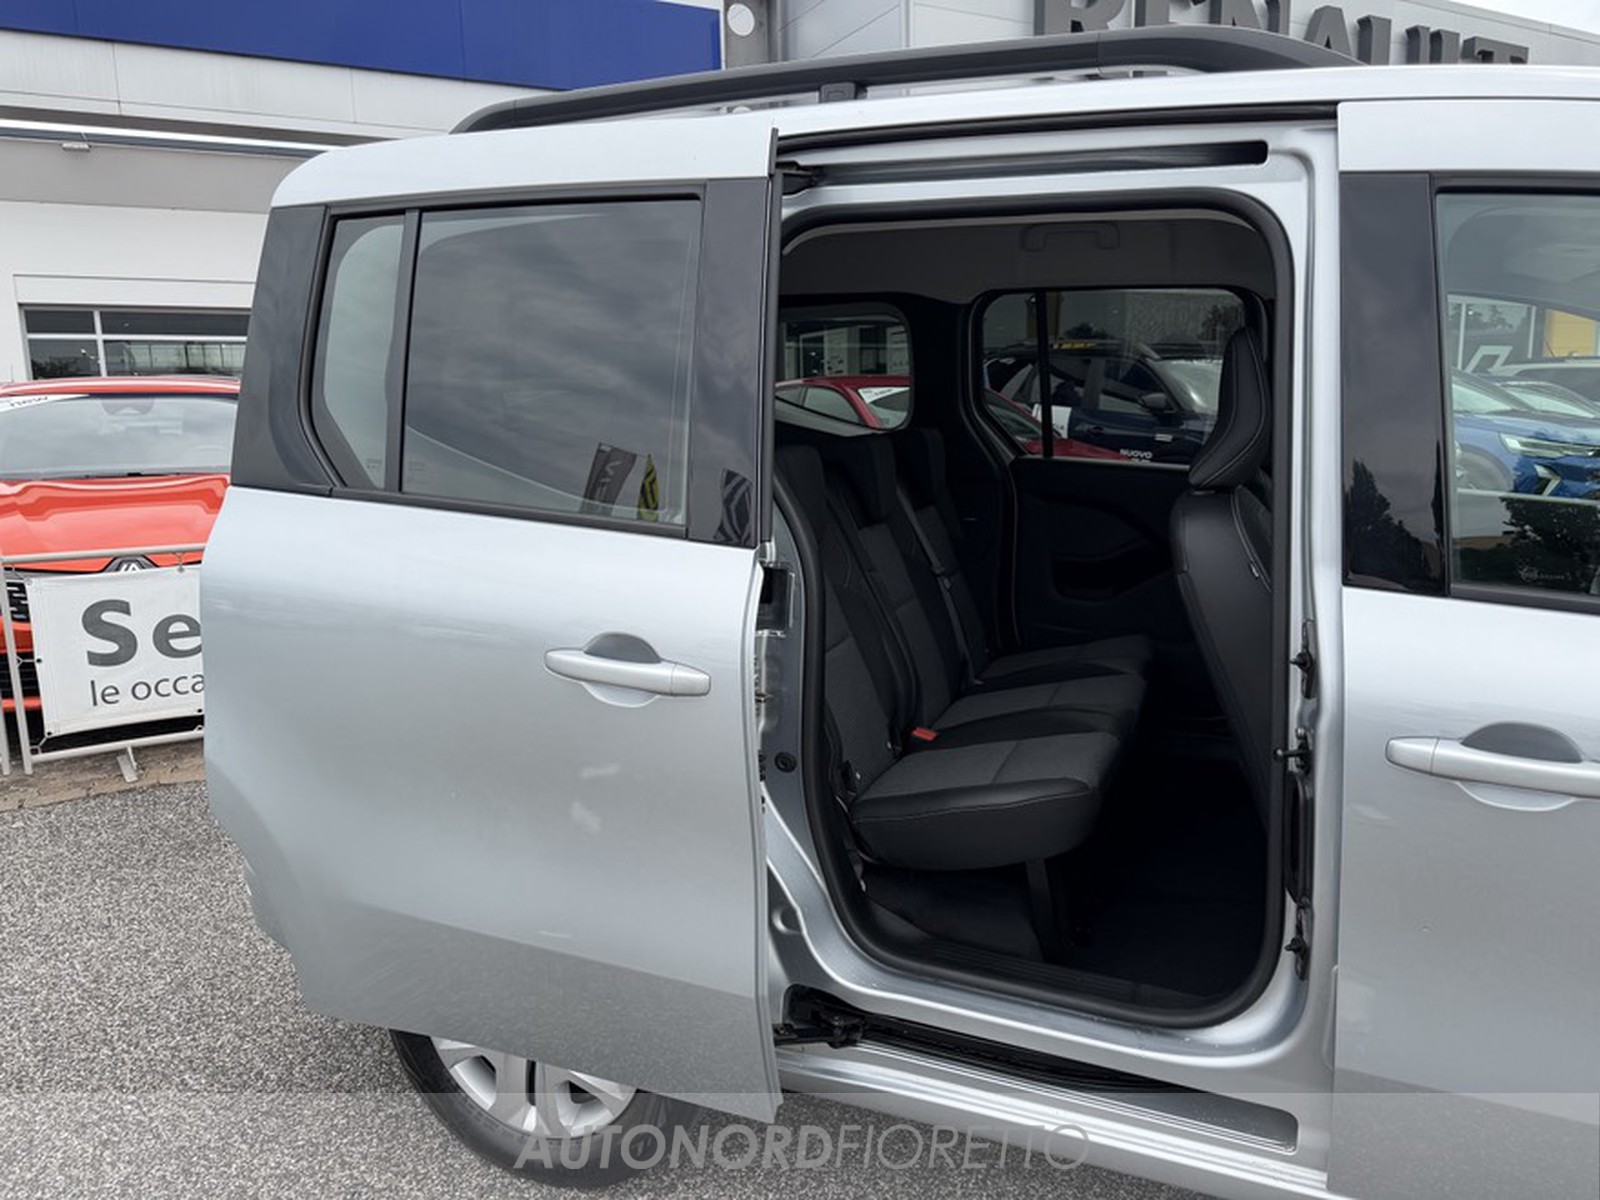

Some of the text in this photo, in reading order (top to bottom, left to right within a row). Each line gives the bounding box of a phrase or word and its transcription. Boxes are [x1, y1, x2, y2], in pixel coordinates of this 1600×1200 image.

[1034, 0, 1529, 65] RNAT
[1119, 448, 1153, 459] NUOVO
[82, 599, 202, 667] Se
[90, 674, 204, 706] le occa
